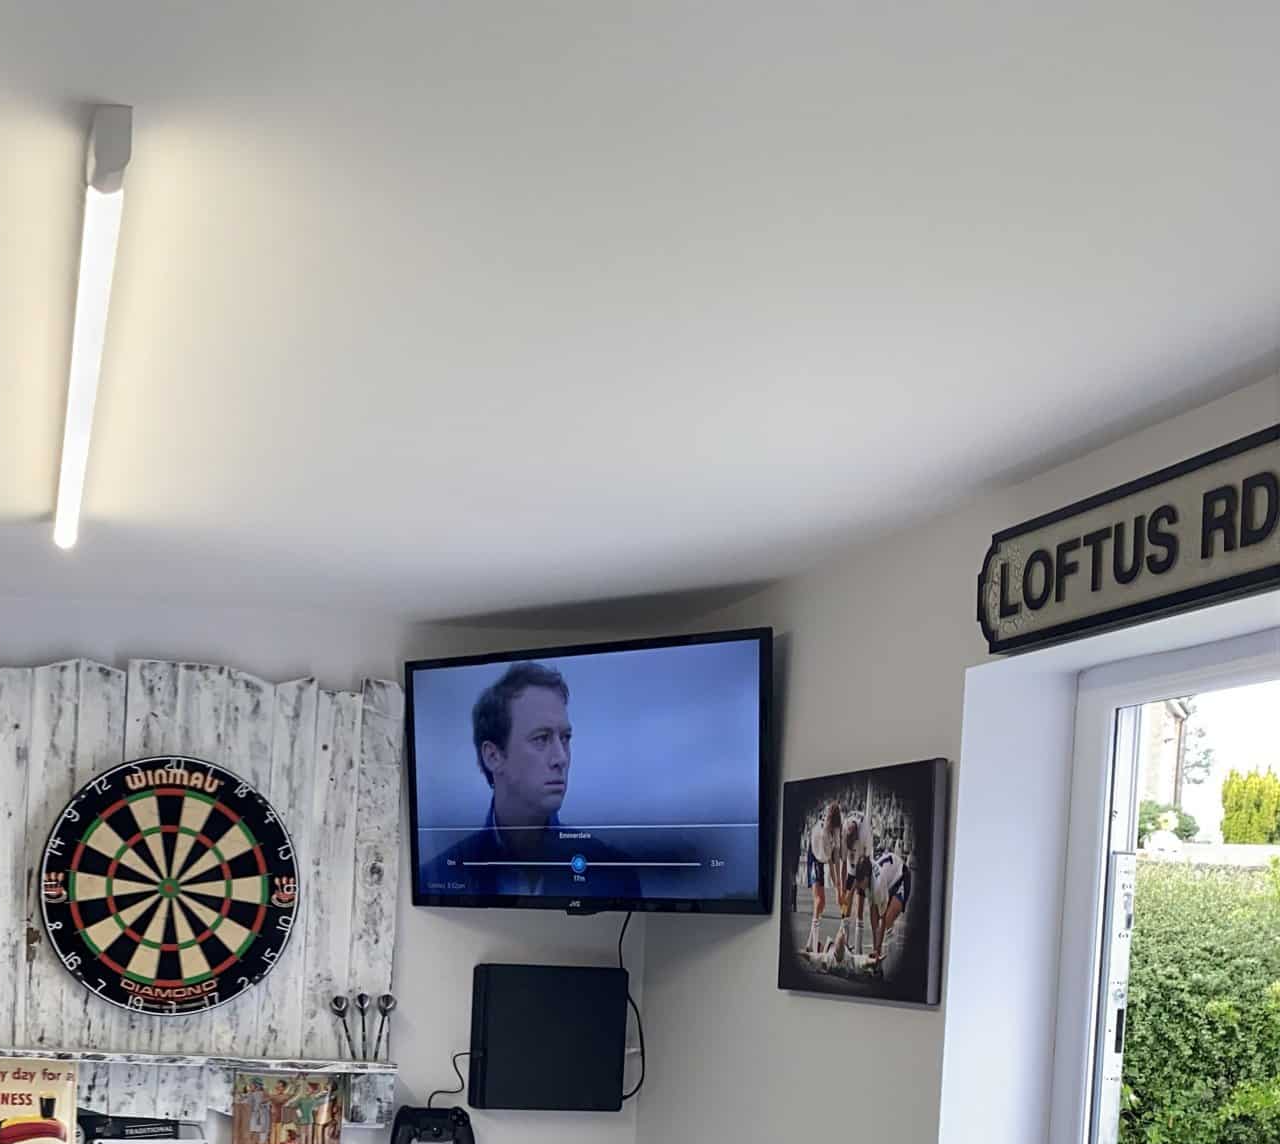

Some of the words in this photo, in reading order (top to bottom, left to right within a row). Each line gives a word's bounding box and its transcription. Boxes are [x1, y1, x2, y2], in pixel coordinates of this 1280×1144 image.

[999, 504, 1179, 619] LOFTUS
[1199, 471, 1280, 560] RD
[119, 978, 219, 998] DIAMOND
[11, 1067, 36, 1083] day
[41, 1068, 61, 1080] for
